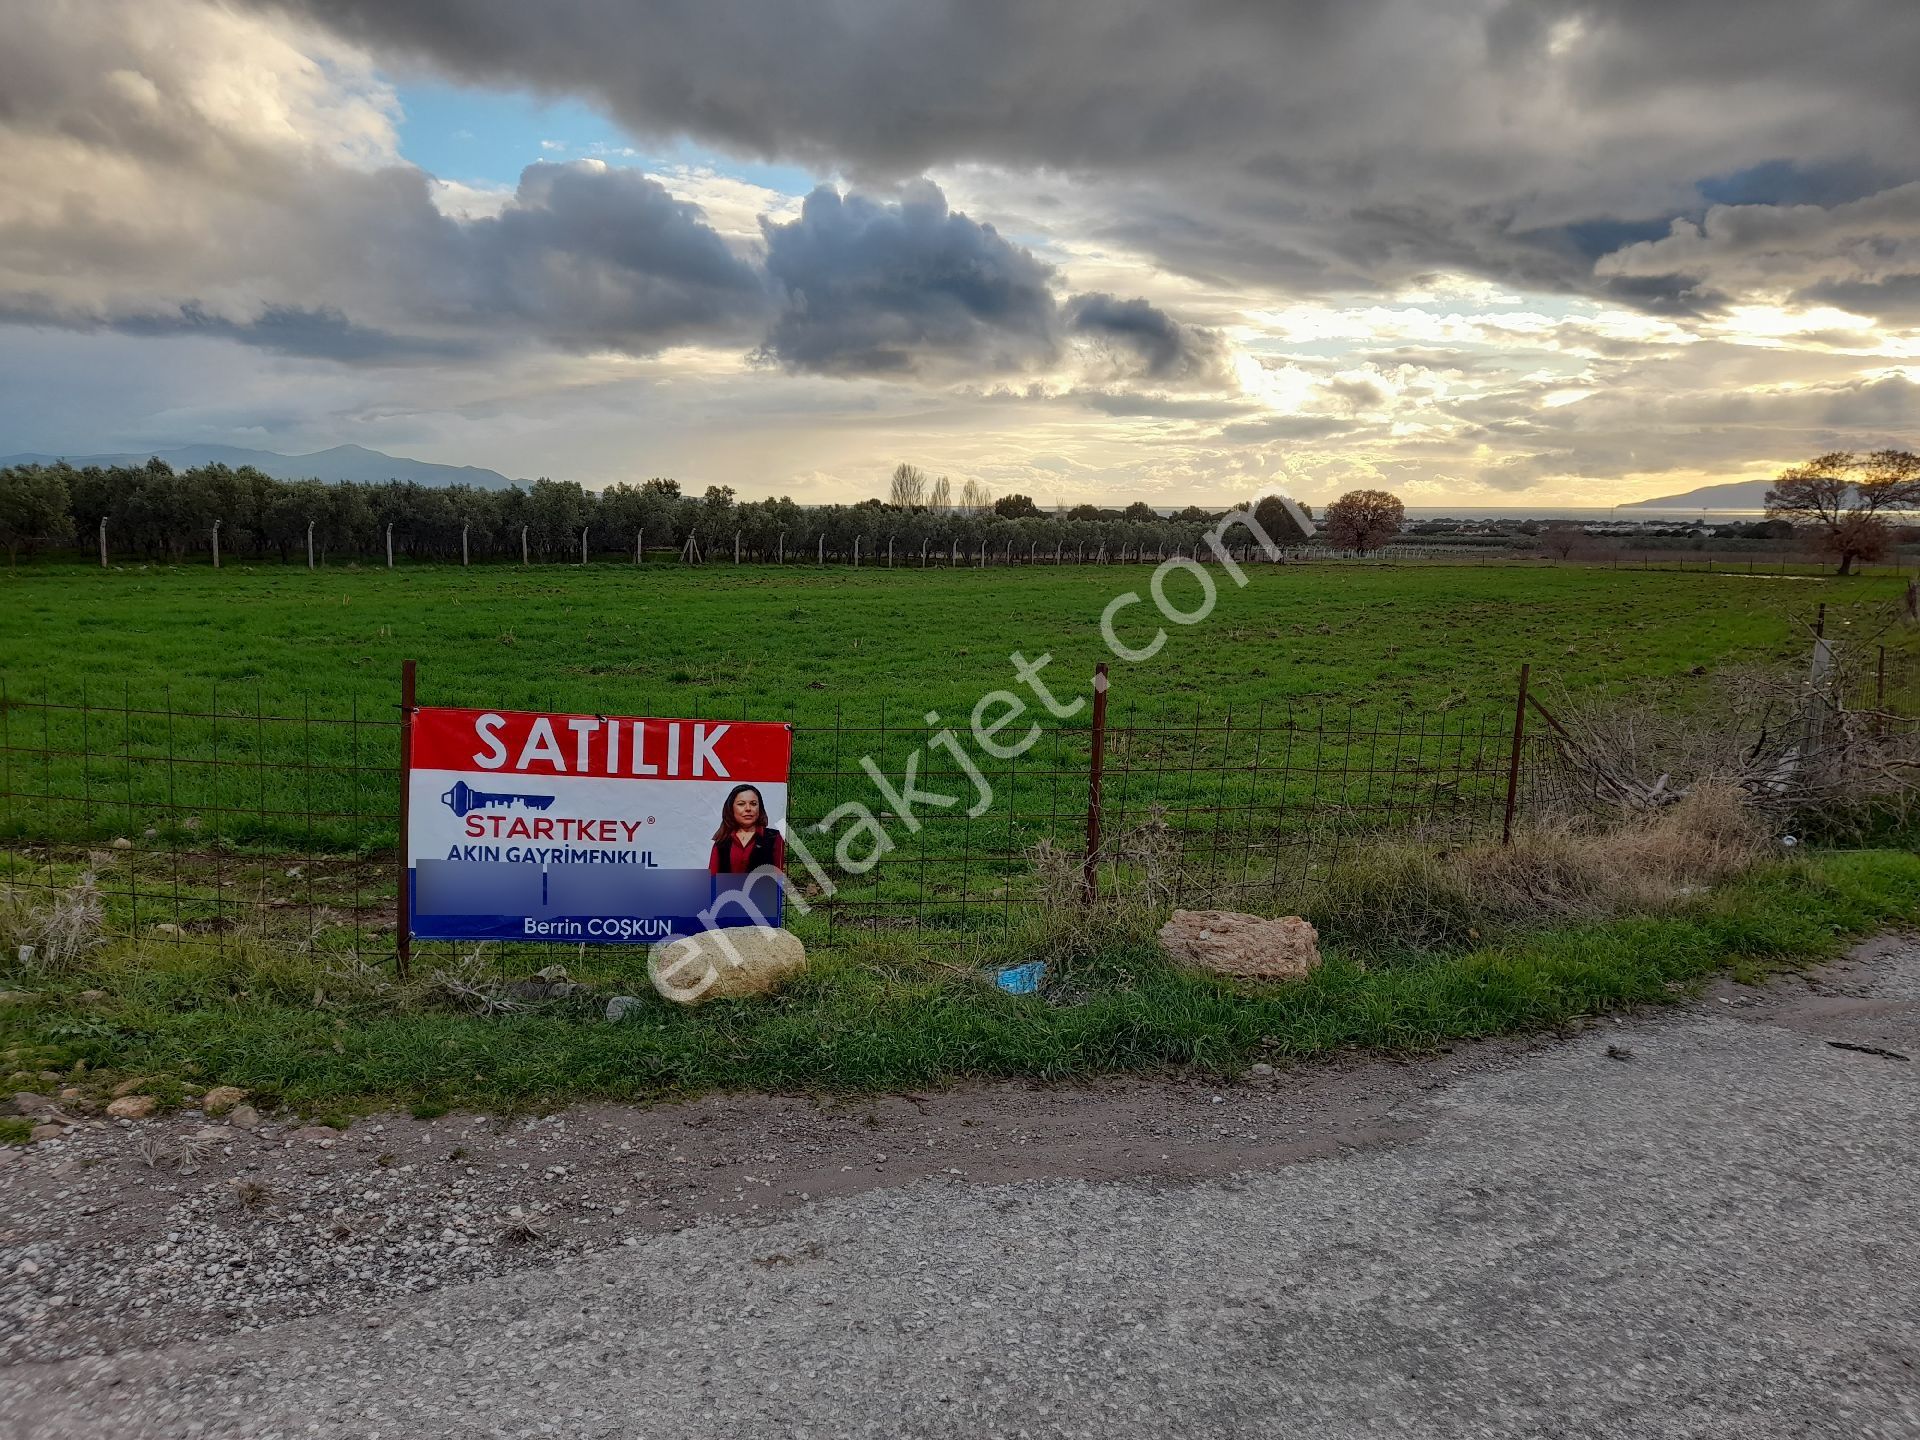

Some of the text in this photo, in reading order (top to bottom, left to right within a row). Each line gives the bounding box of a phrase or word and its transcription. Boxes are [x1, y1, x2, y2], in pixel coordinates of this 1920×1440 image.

[472, 713, 730, 777] SATILIK
[465, 815, 642, 842] STARTKEY
[447, 843, 658, 868] AKIN GAYRİMENKUL
[524, 918, 672, 939] Berrin COŞKUN
